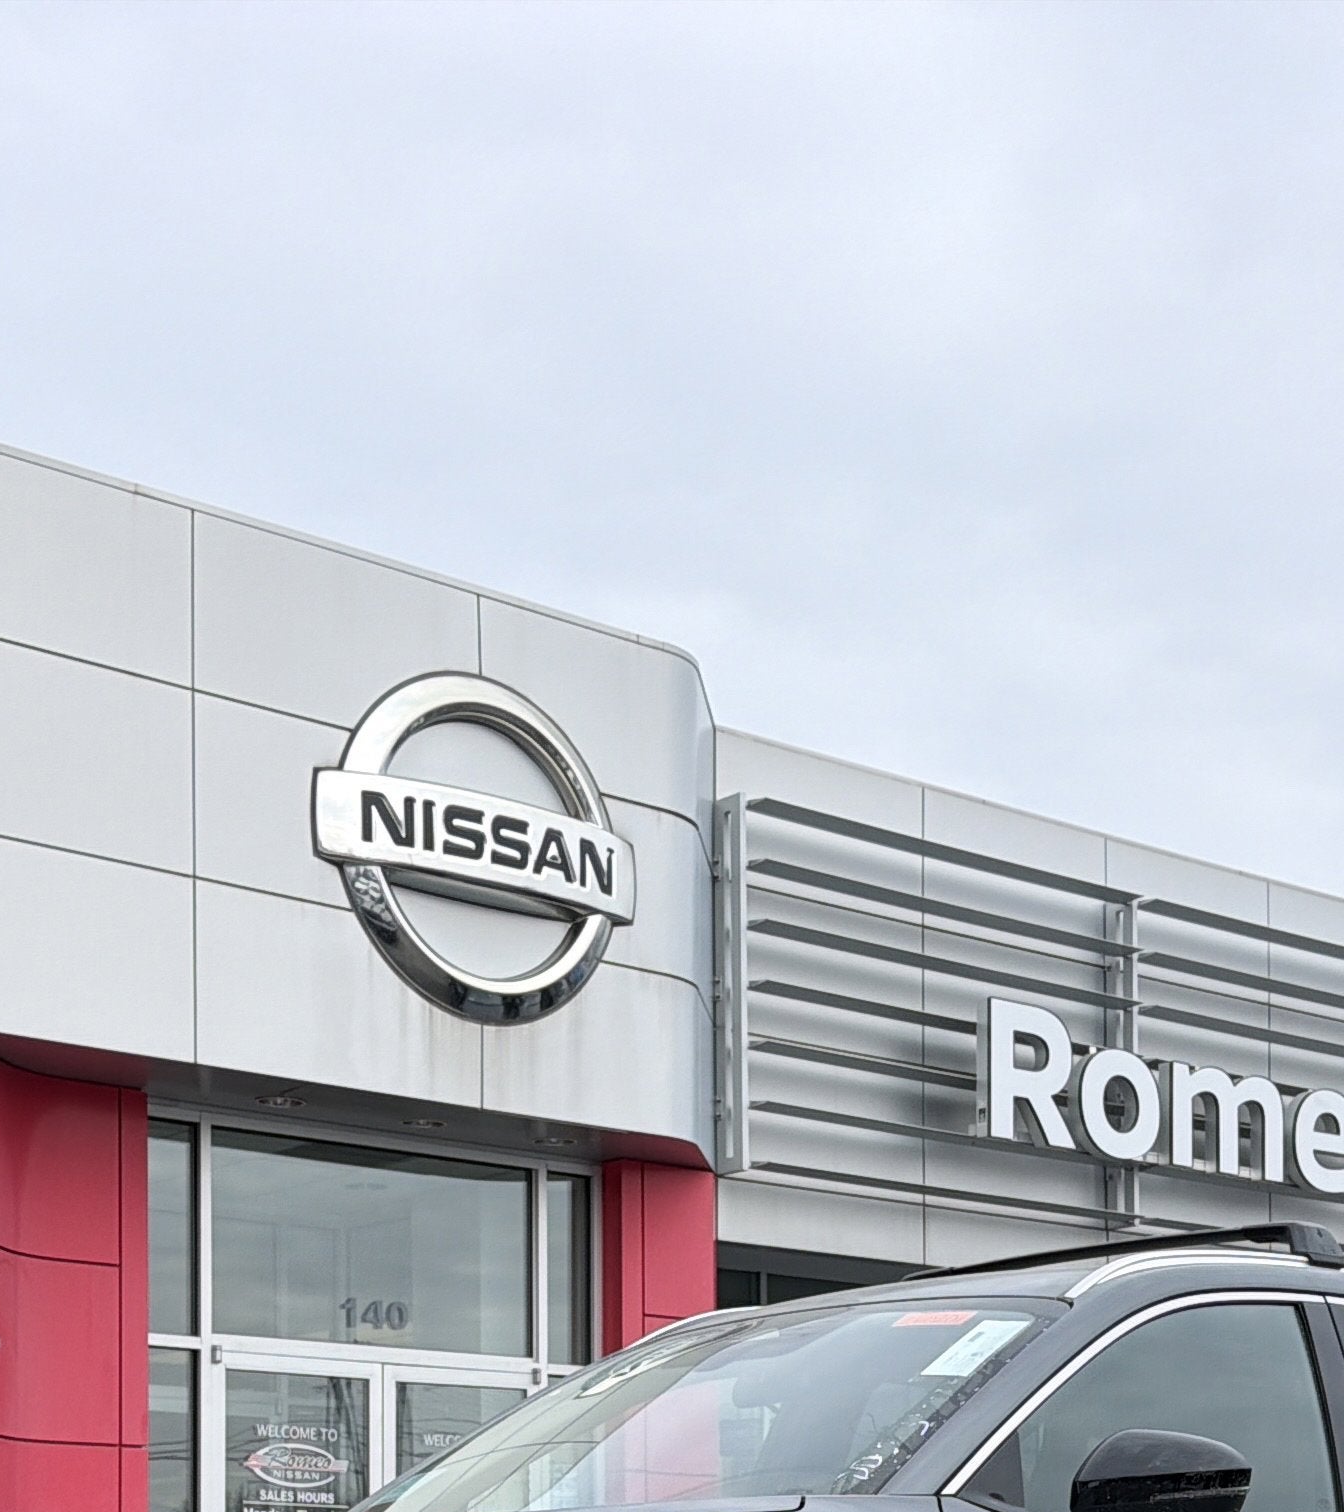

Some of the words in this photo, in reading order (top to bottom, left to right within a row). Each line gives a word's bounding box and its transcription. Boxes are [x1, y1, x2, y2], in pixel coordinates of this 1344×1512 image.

[360, 790, 615, 898] NISSAN
[339, 1298, 408, 1331] 140
[256, 1424, 317, 1440] WELCOME
[321, 1427, 338, 1442] TO
[423, 1433, 461, 1449] WELC
[269, 1446, 333, 1470] Romeo
[272, 1470, 321, 1481] NISSAN
[259, 1488, 294, 1502] SALES
[297, 1491, 335, 1504] HOURS
